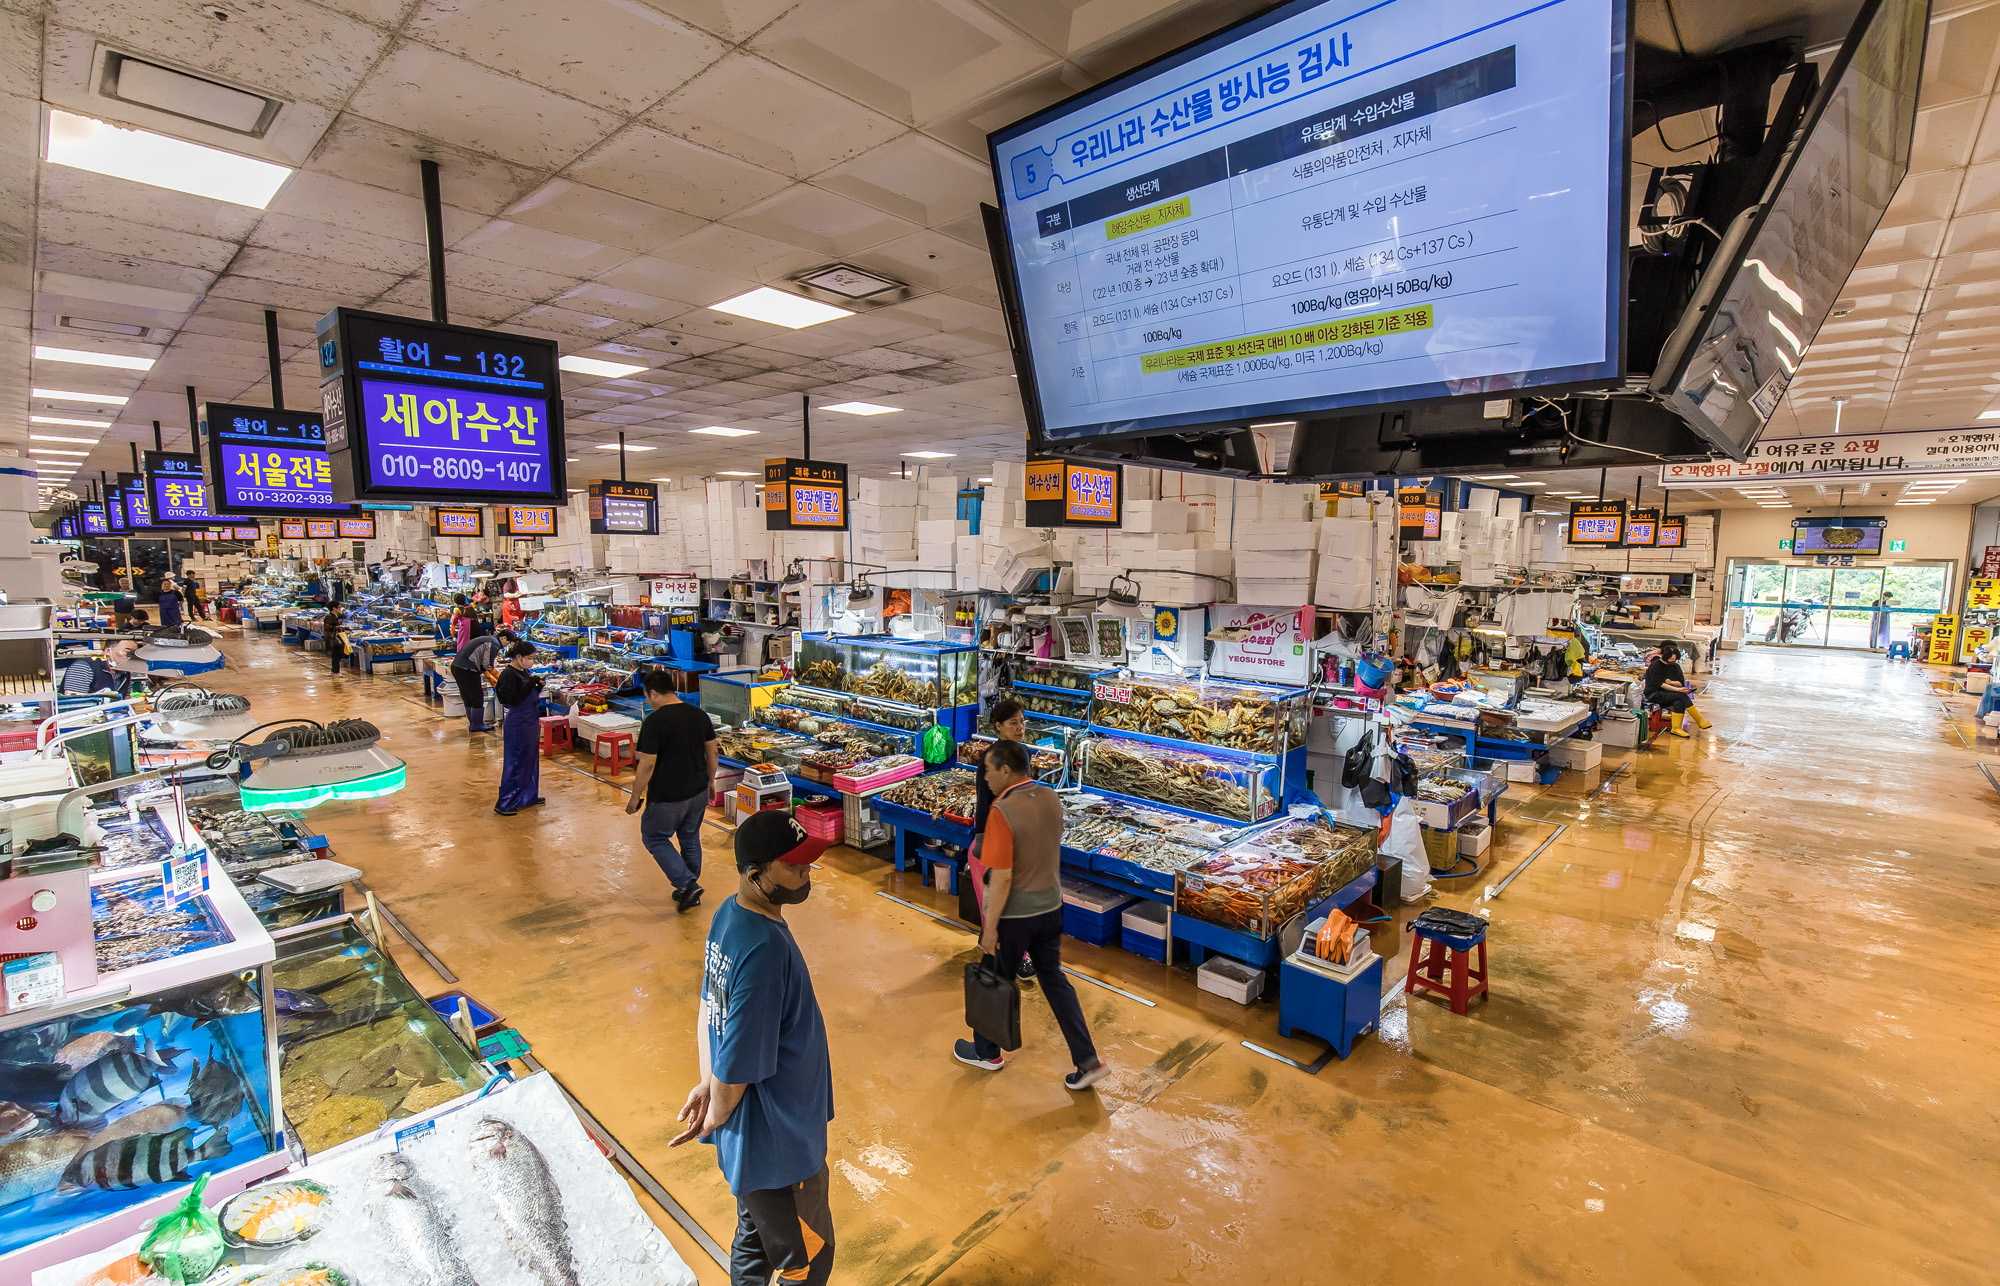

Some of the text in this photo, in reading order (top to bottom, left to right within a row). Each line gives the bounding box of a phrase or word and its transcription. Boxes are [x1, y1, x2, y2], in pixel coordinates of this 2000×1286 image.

[1070, 31, 1353, 168] 우리나라 수산물 방사능 검사
[1301, 114, 1348, 144] 유통단계
[1393, 124, 1433, 150] 지자체
[1025, 163, 1037, 184] 5
[1125, 178, 1161, 202] 생산단계
[1158, 202, 1185, 221] 지자체
[1301, 184, 1428, 232] 유통단계 및 수입 수산물
[1046, 213, 1062, 228] 구분
[1050, 239, 1066, 254] 주체
[1105, 249, 1122, 266] 국내
[1122, 245, 1140, 262] 전체
[1180, 228, 1200, 246] 등의
[1126, 251, 1180, 276] 거래 전 수산물
[1271, 270, 1303, 288] 요오드
[1342, 255, 1366, 273] 세슘
[1057, 280, 1072, 294] 대상
[1107, 284, 1117, 297] 년
[1117, 281, 1133, 294] 100
[1132, 277, 1143, 292] 종
[1169, 268, 1180, 282] 년
[1291, 294, 1343, 315] 100Bq/kg
[1396, 270, 1453, 295] 50Bq/kg)
[1091, 311, 1115, 327] 요오드
[1142, 303, 1160, 317] 세슘
[1063, 320, 1079, 335] 항목
[1142, 327, 1182, 344] 100Bq/kg
[1145, 309, 1428, 370] 우리나라는 국제 표준 및 선진국 대비 10 배 이상 강화된 기준 적용
[378, 336, 430, 367] 활어
[476, 351, 526, 379] 132
[1177, 369, 1198, 384] (세슘
[1198, 363, 1235, 380] 국제표준
[1294, 350, 1316, 364] 미국
[1318, 338, 1384, 363] 1,200Bq/kg)
[1071, 366, 1086, 379] 기준
[232, 417, 268, 435] 활어
[298, 423, 326, 439] 13
[380, 392, 539, 446] 세아수산
[1766, 441, 1836, 458] 여유로운
[1843, 439, 1880, 454] 쇼핑
[1925, 446, 1949, 456] 절대
[162, 459, 189, 472] 활어
[381, 453, 542, 483] 010-8609-1407
[769, 468, 781, 478] 011
[795, 467, 810, 477] 패류
[821, 469, 837, 480] 011
[1670, 455, 1910, 478] 호객행위 근절에서 시작됩니다.
[634, 487, 649, 496] 010
[1028, 472, 1060, 492] 여수상회
[1070, 471, 1113, 505] 여수상회
[237, 490, 333, 505] 010-3202-939
[794, 488, 839, 513] 영광해물2
[1404, 495, 1420, 503] 039
[441, 514, 477, 528] 대박수산
[1576, 518, 1617, 534] 태한물산
[654, 581, 698, 594] 문어전문
[1228, 655, 1285, 667] YEOSU STORE
[1094, 684, 1132, 705] 킹크랩
